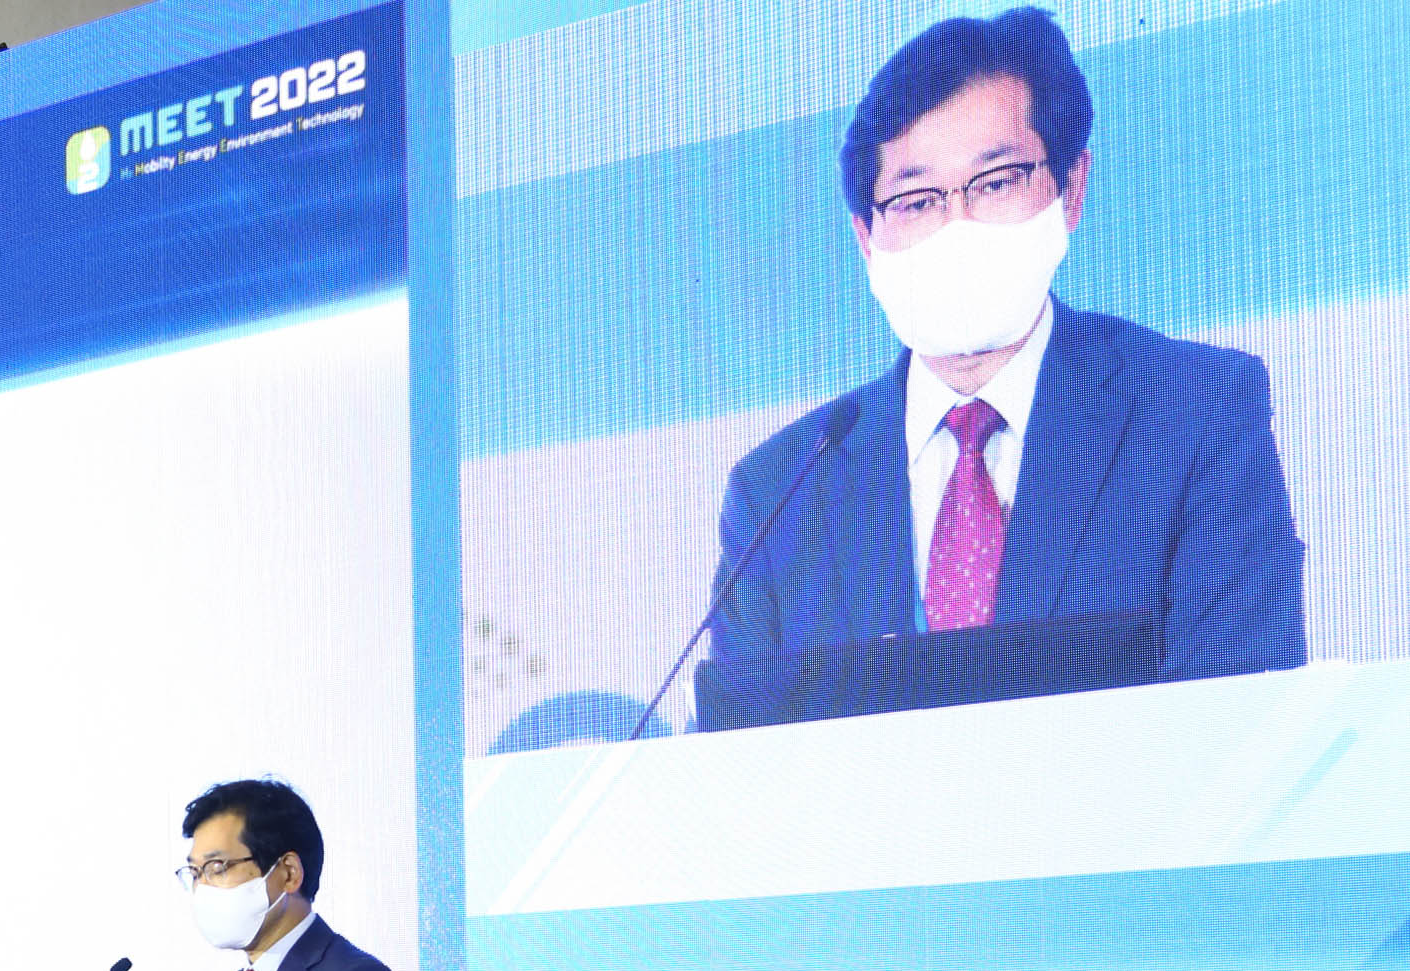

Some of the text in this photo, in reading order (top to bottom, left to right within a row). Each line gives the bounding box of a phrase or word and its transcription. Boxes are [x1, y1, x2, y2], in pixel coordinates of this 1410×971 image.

[119, 49, 366, 156] MEET 2022
[177, 143, 218, 166] Energy
[220, 121, 293, 153] Environment
[296, 102, 365, 131] Technology
